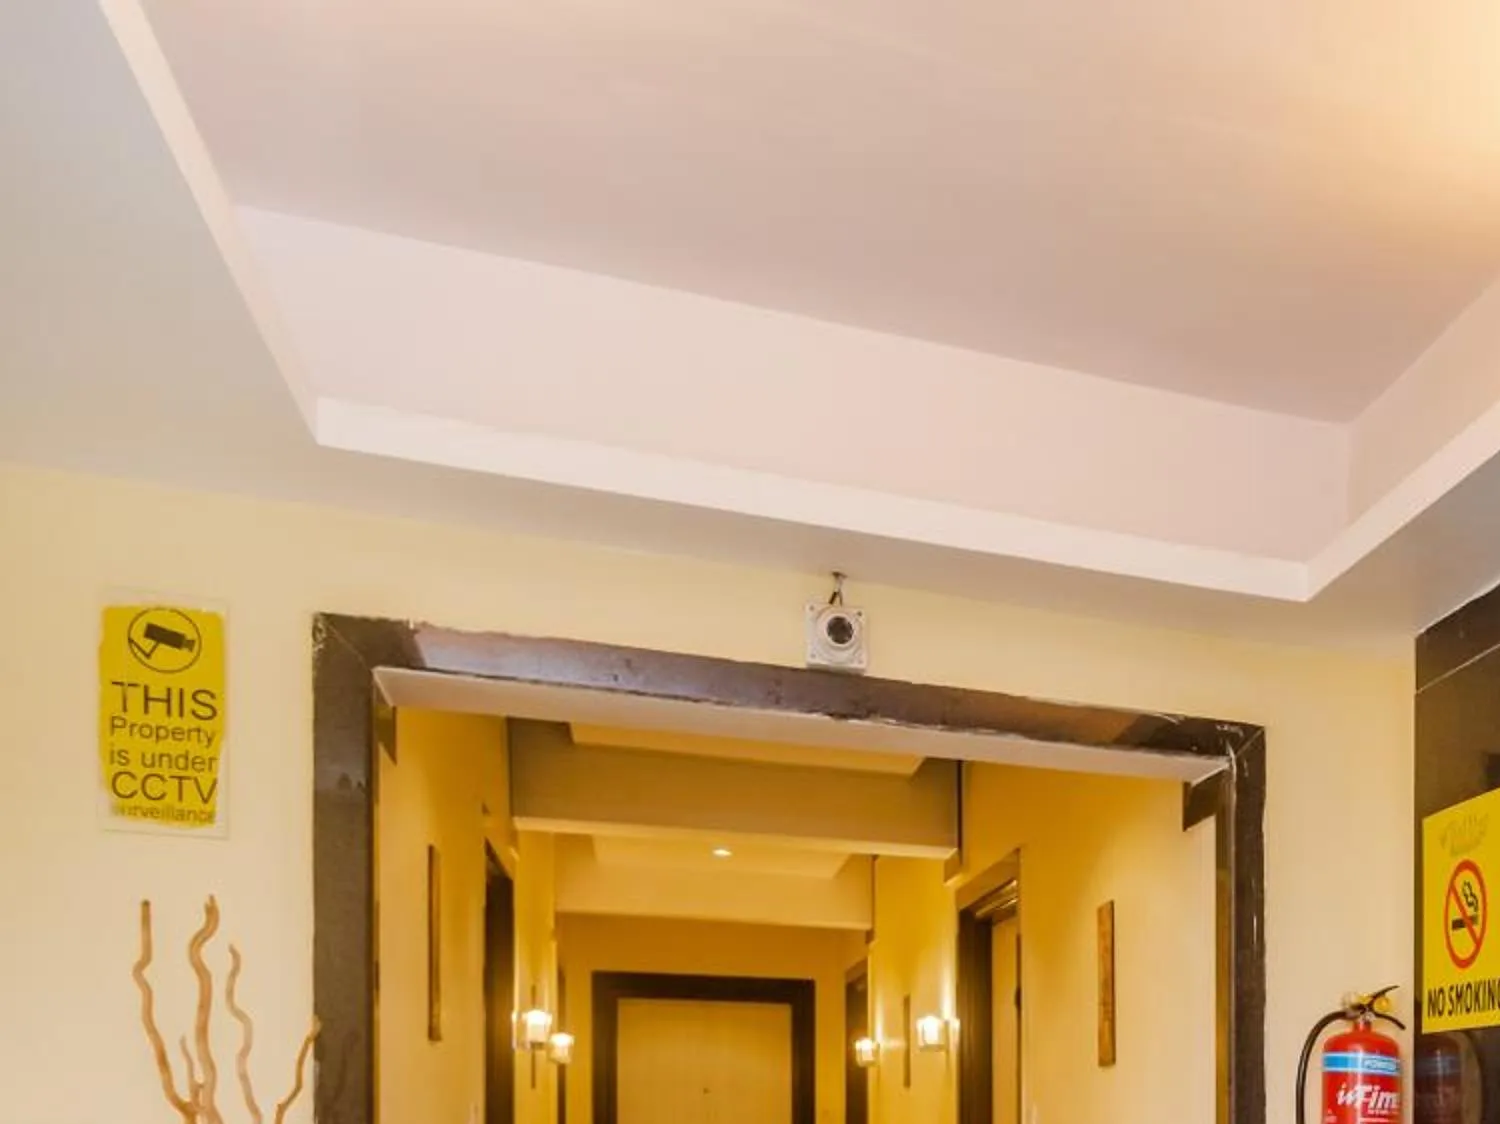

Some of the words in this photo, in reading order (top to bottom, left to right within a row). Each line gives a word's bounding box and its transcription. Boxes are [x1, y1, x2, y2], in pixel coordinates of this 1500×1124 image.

[111, 681, 218, 721] THIS
[110, 716, 216, 748] Property
[109, 743, 130, 766] is
[141, 750, 219, 773] under
[111, 771, 218, 805] CCTV
[1427, 987, 1445, 1018] NO
